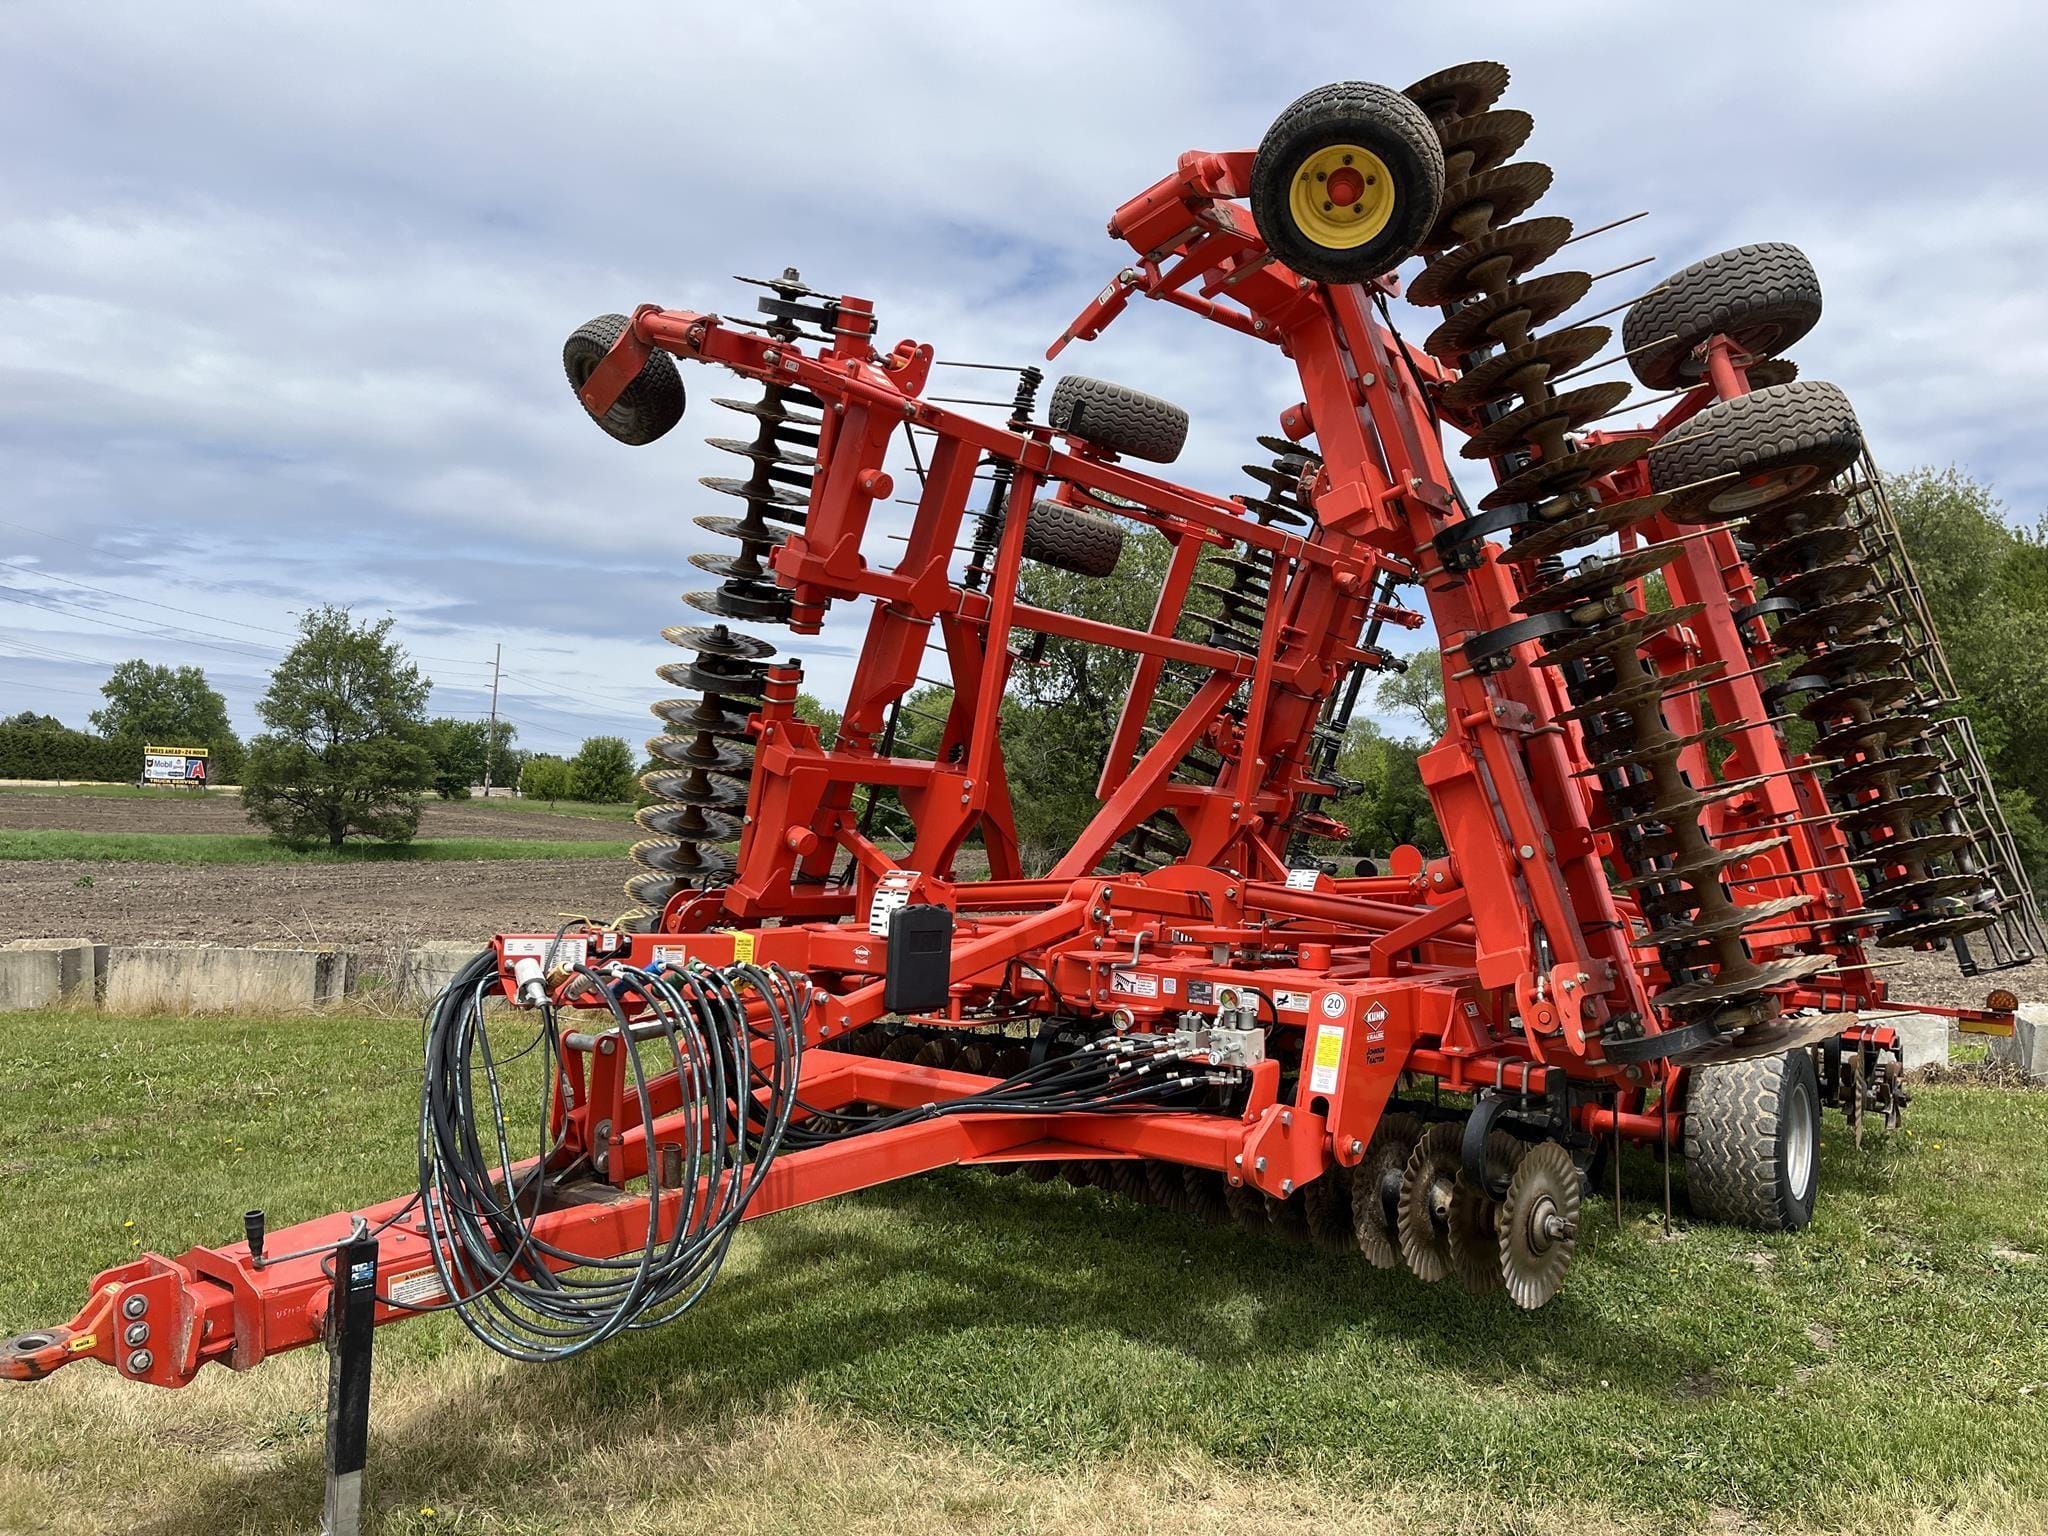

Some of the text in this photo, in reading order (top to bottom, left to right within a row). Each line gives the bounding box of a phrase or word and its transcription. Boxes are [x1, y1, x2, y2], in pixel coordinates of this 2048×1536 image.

[154, 760, 173, 768] Mobil
[186, 759, 205, 778] TA
[890, 889, 897, 897] 5
[885, 905, 891, 914] 3
[883, 921, 888, 929] 1
[1326, 998, 1341, 1010] 20
[1367, 1010, 1385, 1023] KUHN
[409, 1267, 436, 1279] WARNING
